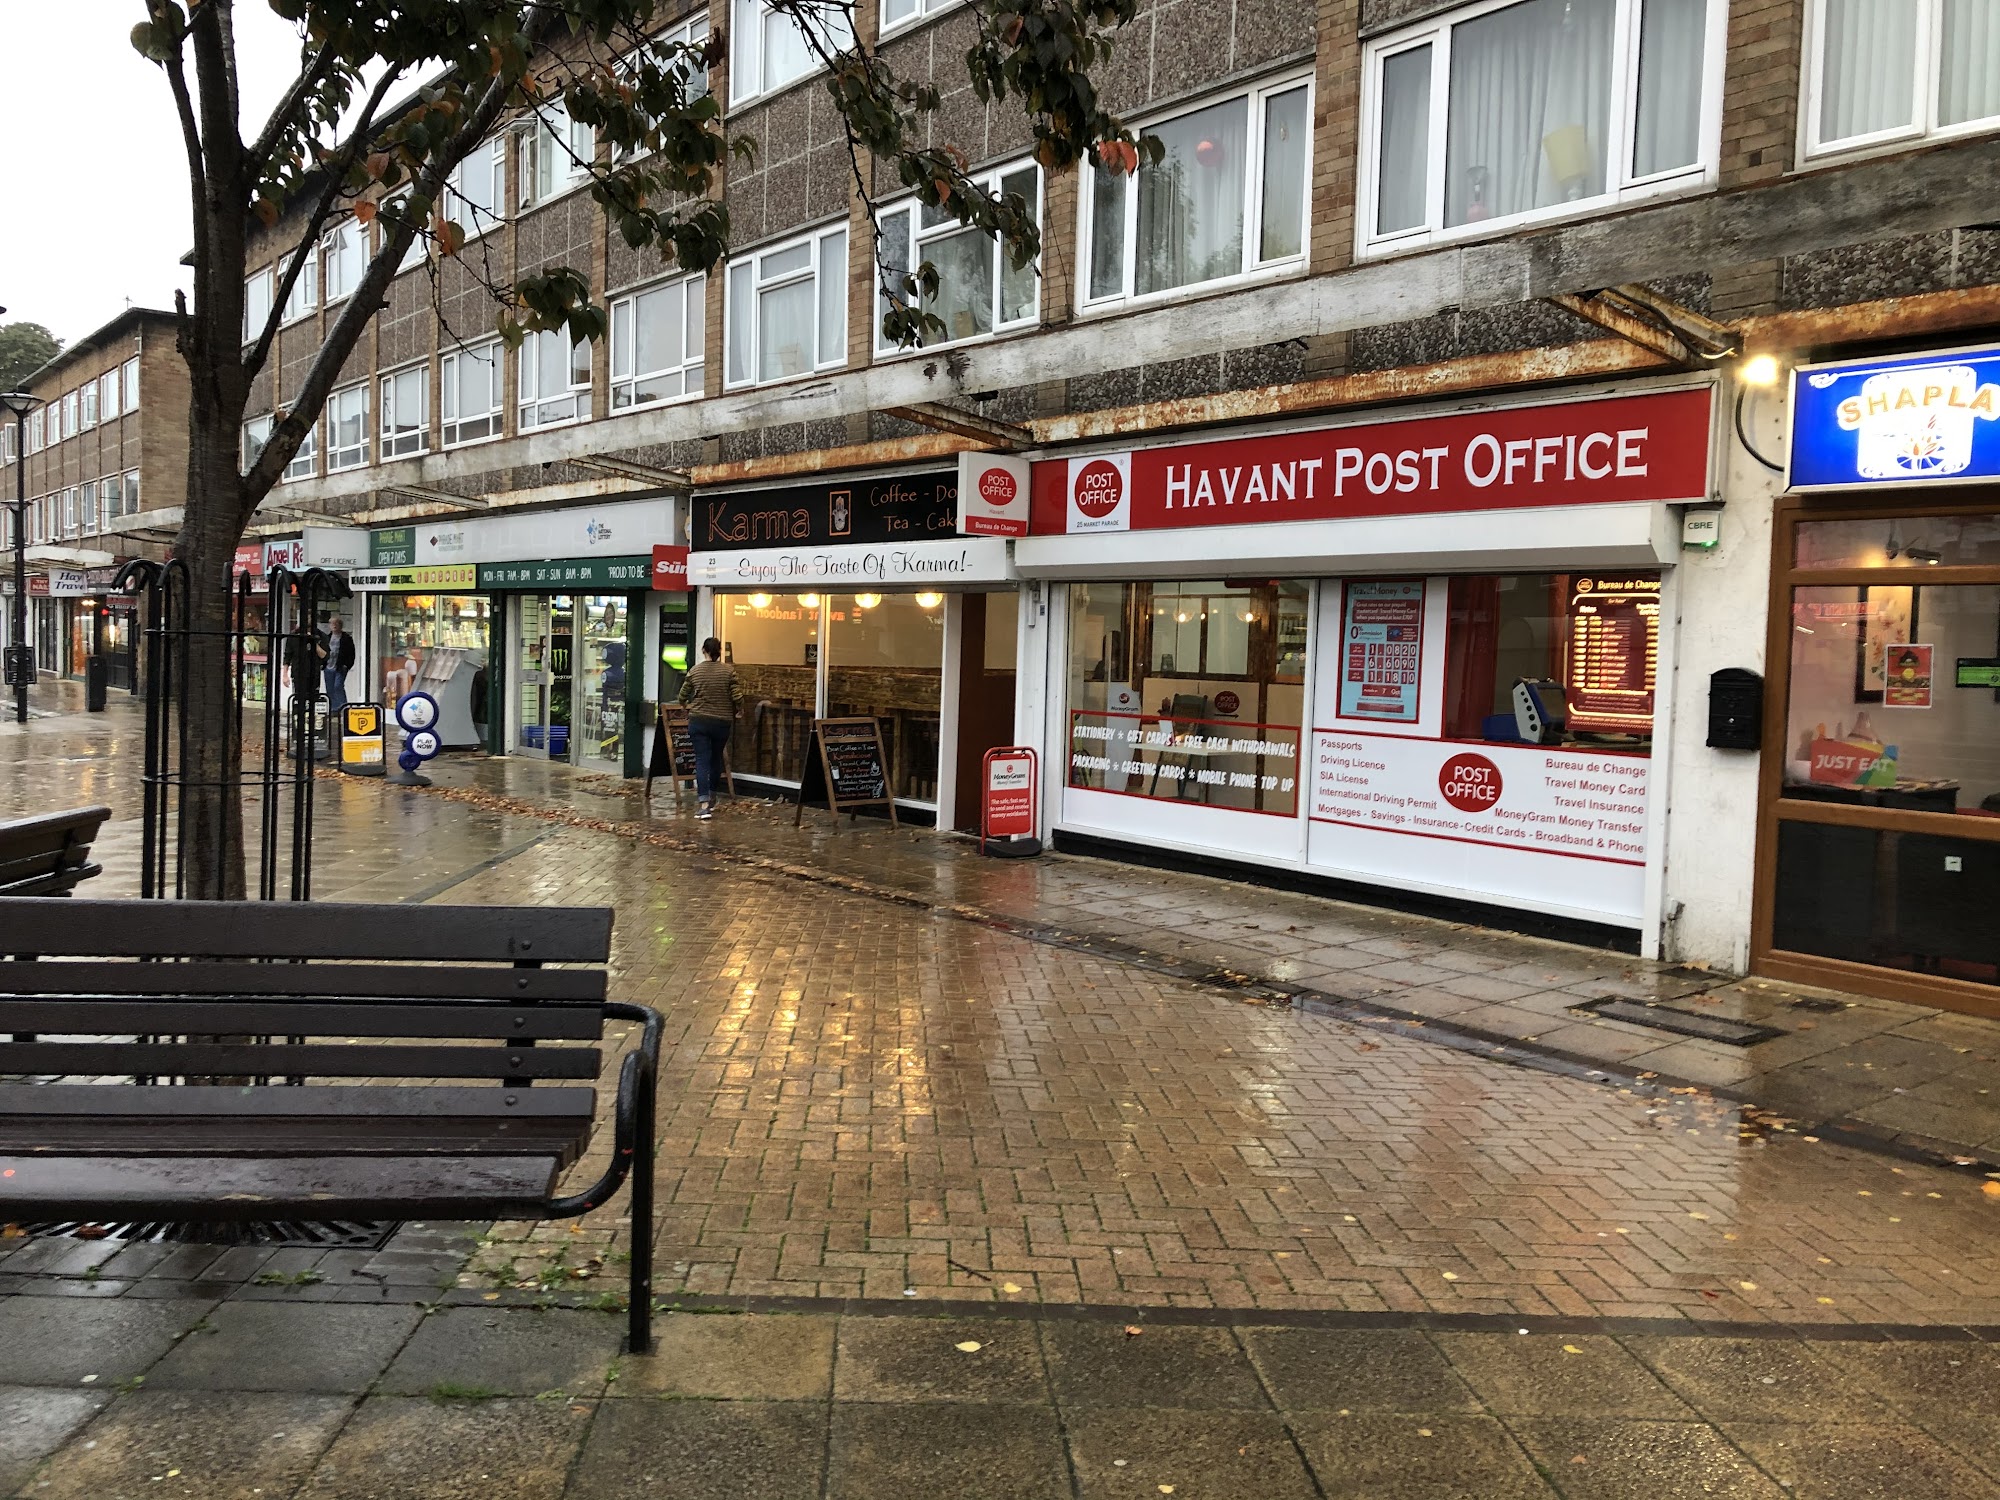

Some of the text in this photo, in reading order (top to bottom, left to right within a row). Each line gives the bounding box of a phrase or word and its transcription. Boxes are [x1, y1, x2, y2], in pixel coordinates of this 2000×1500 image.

[1841, 384, 1993, 424] SHAPLA
[1165, 426, 1649, 509] HAVANT POST OFFICE
[987, 474, 1010, 486] POST
[1086, 472, 1114, 489] POST
[870, 484, 958, 507] Coffee Do
[982, 485, 1013, 498] OFFICE
[1079, 488, 1117, 506] OFFICE
[708, 501, 811, 542] Karma
[883, 515, 909, 532] Tea
[975, 521, 993, 530] Bureau
[1000, 523, 1018, 532] Change
[1101, 519, 1119, 527] PARADE
[1687, 521, 1713, 530] CBRE
[320, 557, 357, 565] OFF LICENCE
[378, 551, 390, 565] OPEN
[394, 550, 407, 564] DAYS
[708, 557, 716, 565] 23
[536, 568, 546, 580] SAT
[550, 568, 561, 580] SUN
[627, 565, 636, 578] TO
[637, 565, 645, 578] BE
[779, 555, 808, 576] The
[813, 554, 860, 577] Taste
[863, 553, 886, 580] Of
[55, 581, 84, 590] Trave
[60, 572, 83, 582] Hay
[1597, 579, 1661, 591] Bureau de Change
[1375, 586, 1398, 596] Money
[1217, 701, 1238, 709] OFFICE
[1073, 725, 1296, 758] STATIONERY GIFT CARDS FREE CASH WITHDRAWALS
[1321, 738, 1363, 751] Passports
[1320, 755, 1386, 770] Driving Licence
[1546, 758, 1647, 779] Bureau de Change
[1815, 754, 1891, 772] JUST EAT
[1071, 754, 1295, 792] PACKAGING GREETING CARDS MOBILE PHONE TOP UP
[1320, 771, 1369, 785] SIA License
[1453, 765, 1492, 784] POST
[1444, 781, 1496, 801] OFFICE
[1544, 776, 1646, 796] Travel Money Card
[1319, 786, 1437, 810] International Driving Permit
[1554, 796, 1645, 814] Travel Insurance
[1318, 803, 1644, 854] Mortgages Savings Insurance Credit Cards Broadband & Phone
[1495, 808, 1643, 834] MoneyGram Money Transfer
